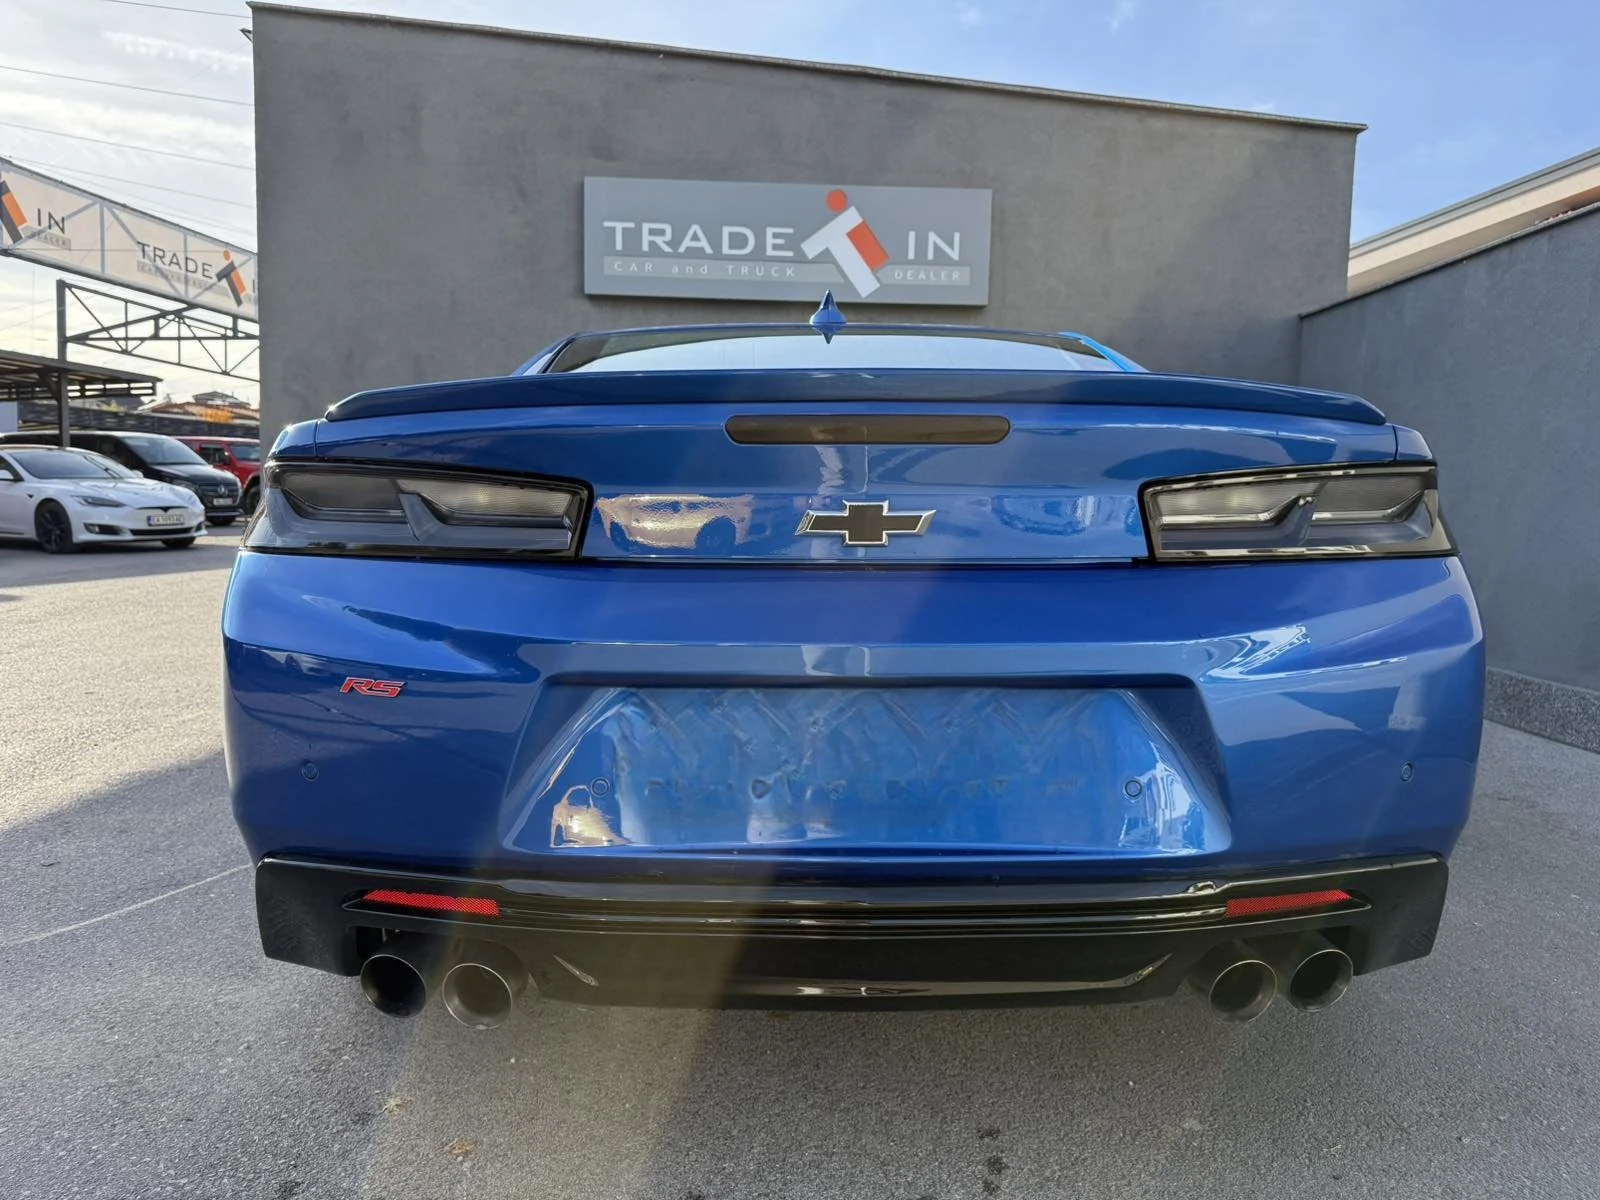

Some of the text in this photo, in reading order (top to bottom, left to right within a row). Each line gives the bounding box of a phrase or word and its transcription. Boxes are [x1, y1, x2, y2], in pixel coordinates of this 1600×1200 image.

[36, 207, 66, 235] IN
[602, 220, 795, 257] TRADE
[907, 230, 961, 262] IN
[136, 240, 214, 280] TRADE
[613, 261, 796, 278] CAR and TRUCK
[894, 268, 962, 282] DEALER
[340, 676, 406, 698] RS
